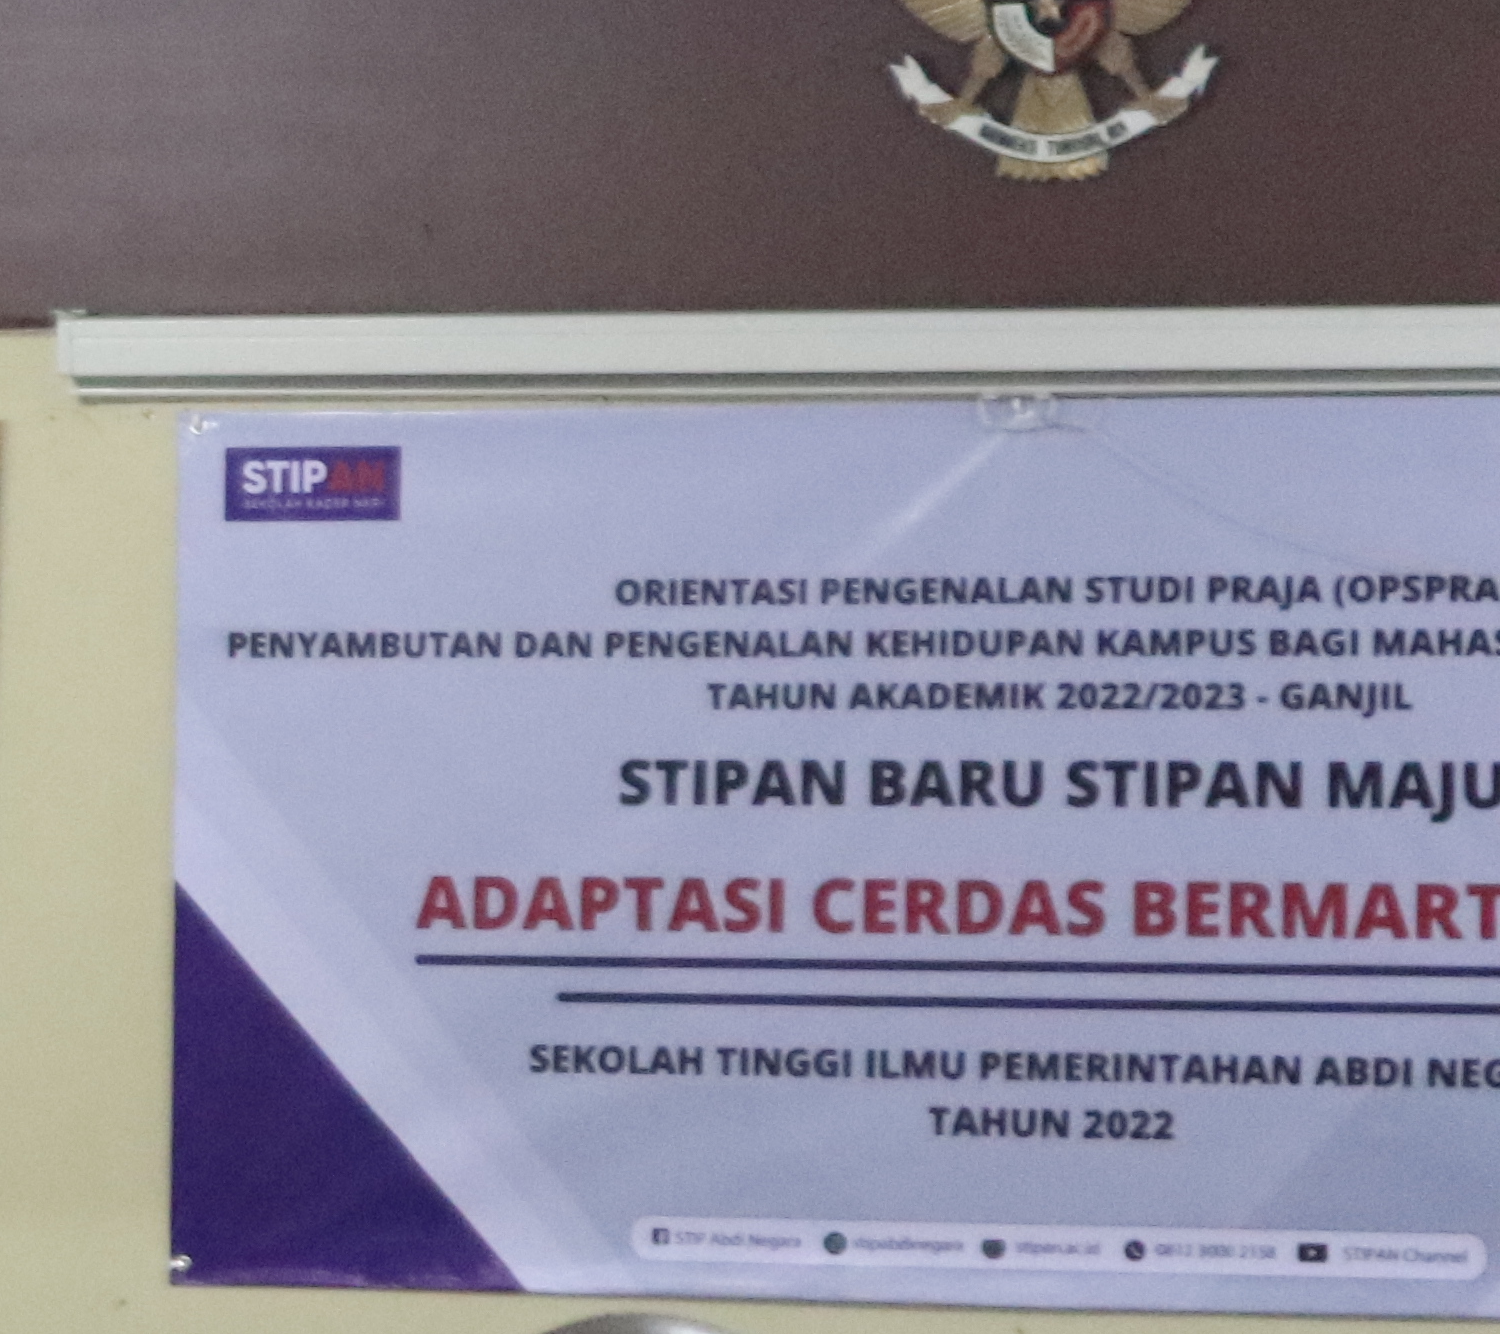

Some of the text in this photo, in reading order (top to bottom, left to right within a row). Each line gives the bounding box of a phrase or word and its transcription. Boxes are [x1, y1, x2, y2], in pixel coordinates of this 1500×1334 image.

[614, 573, 1500, 612] ORIENTASI PENGENALAN STUDI PRAJA (OPSPRA
[227, 631, 502, 659] PENYAMBUTAN
[513, 630, 593, 659] DAN
[604, 629, 853, 659] PENGENALAN
[865, 628, 1084, 658] KEHIDUPAN
[1096, 628, 1257, 658] KAMPUS
[1268, 628, 1356, 658] BAGI
[706, 682, 837, 711] TAHUN
[848, 682, 1045, 711] AKADEMIK
[1056, 681, 1246, 712] 2022/2023
[1278, 681, 1413, 719] GANJIL
[619, 758, 1500, 824] STIPAN BARU STIPAN MAJU
[415, 875, 1500, 941] ADAPTASI CERDAS BERMART
[529, 1043, 704, 1076] SEKOLAH
[715, 1046, 853, 1079] TINGGI
[865, 1048, 966, 1082] ILMU
[978, 1050, 1302, 1086] PEMERINTAHAN
[1313, 1055, 1414, 1089] ABDI
[928, 1105, 1175, 1141] TAHUN 2022
